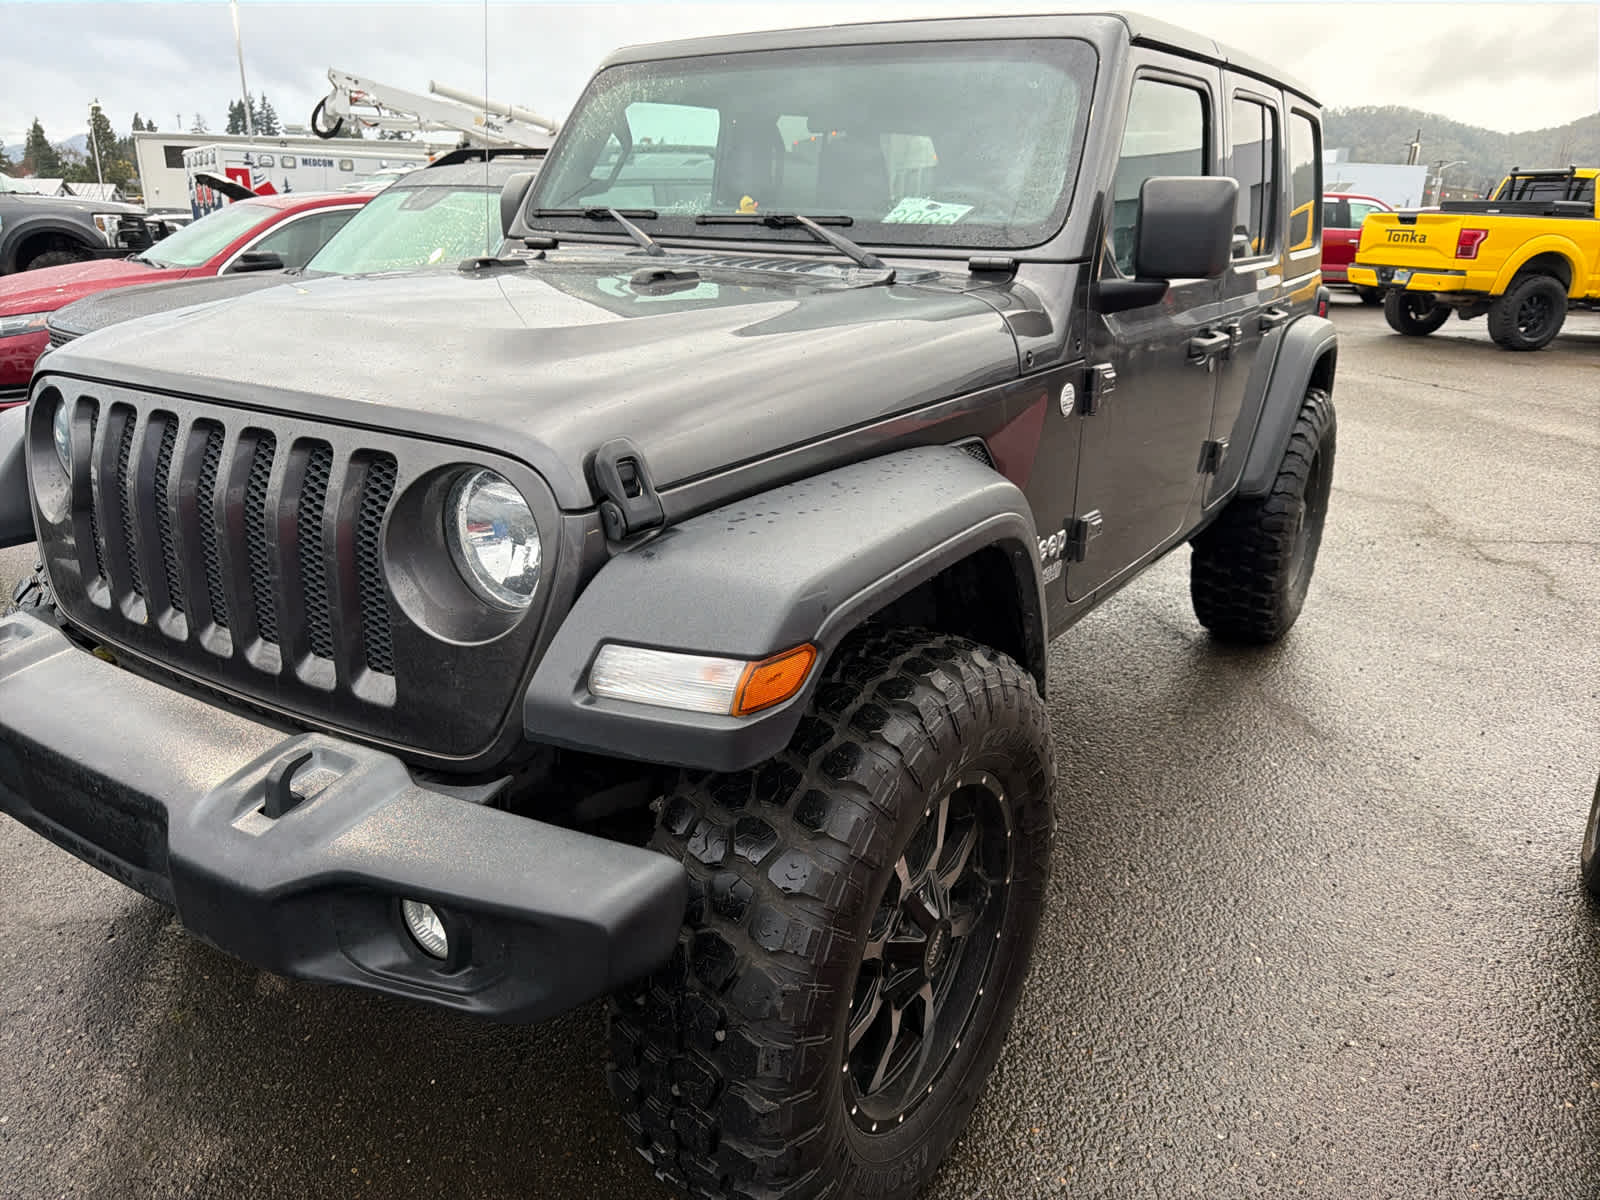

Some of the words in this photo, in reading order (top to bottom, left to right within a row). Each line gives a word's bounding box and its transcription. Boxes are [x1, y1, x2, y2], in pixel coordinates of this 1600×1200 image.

[302, 157, 334, 168] MEDCOM
[1385, 229, 1427, 243] Tonka
[1037, 529, 1067, 560] eep
